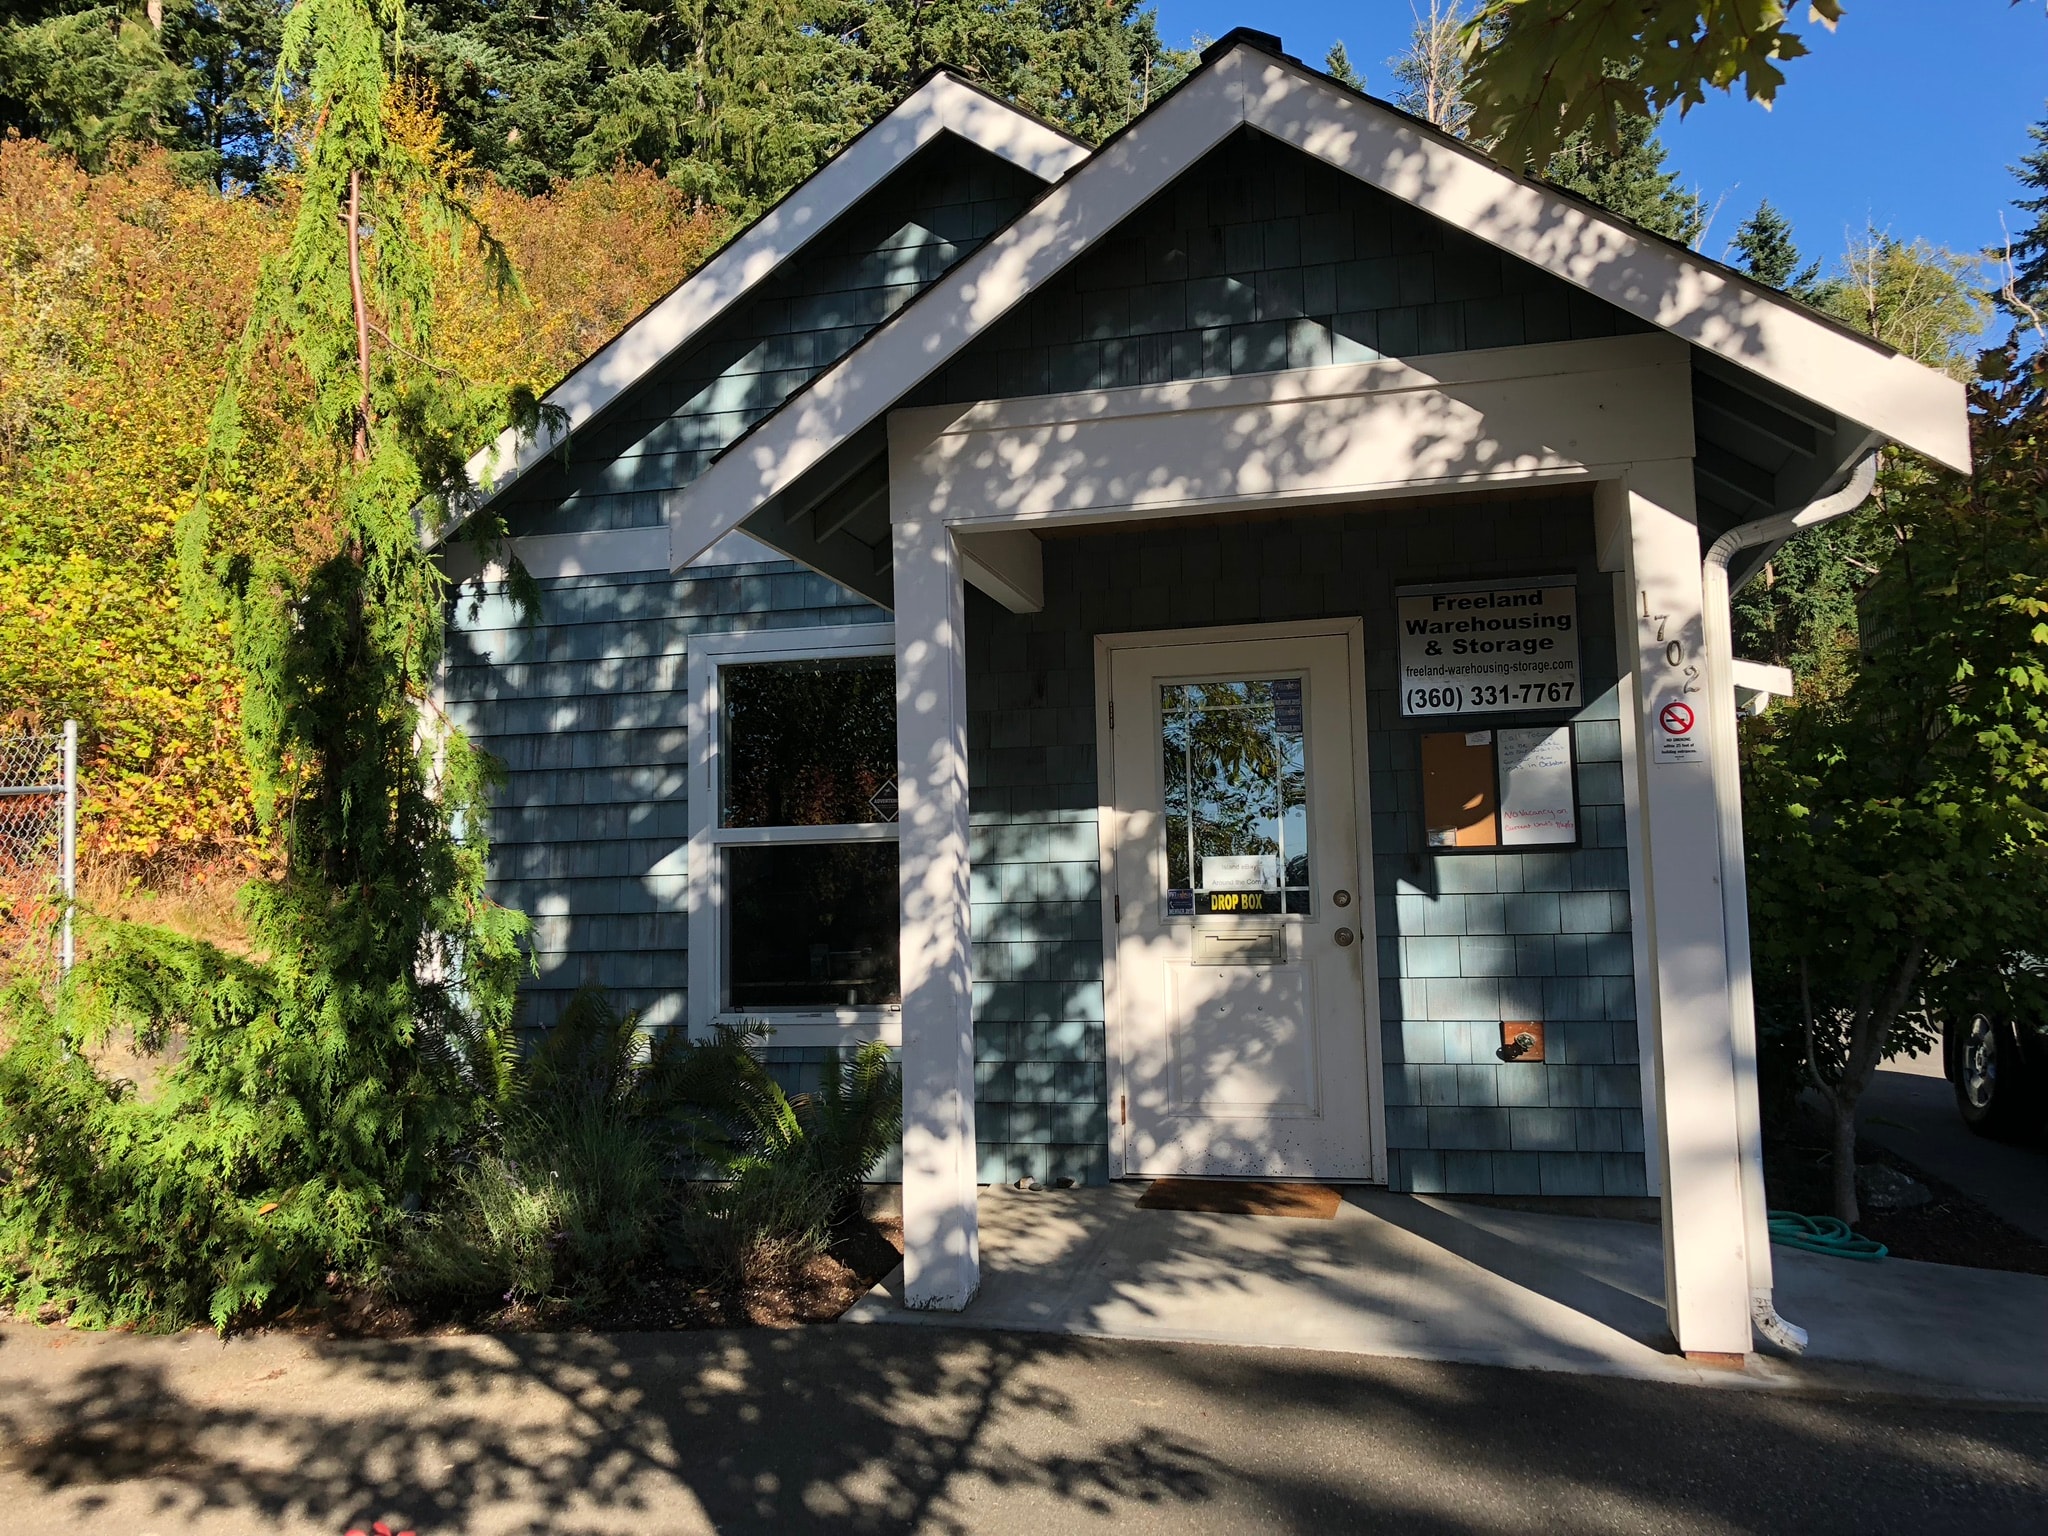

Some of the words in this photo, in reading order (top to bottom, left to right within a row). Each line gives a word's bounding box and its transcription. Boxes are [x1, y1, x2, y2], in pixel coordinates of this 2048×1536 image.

[1432, 590, 1543, 611] Freeland
[1405, 613, 1572, 635] Warehousing
[1424, 640, 1443, 656] &
[1452, 637, 1554, 655] Storage
[1405, 660, 1574, 677] freeland-warehousing-storage.com
[1406, 687, 1463, 713] (360)
[1470, 682, 1575, 705] 331-7767
[1211, 893, 1239, 911] DROP
[1241, 893, 1263, 910] BOX
